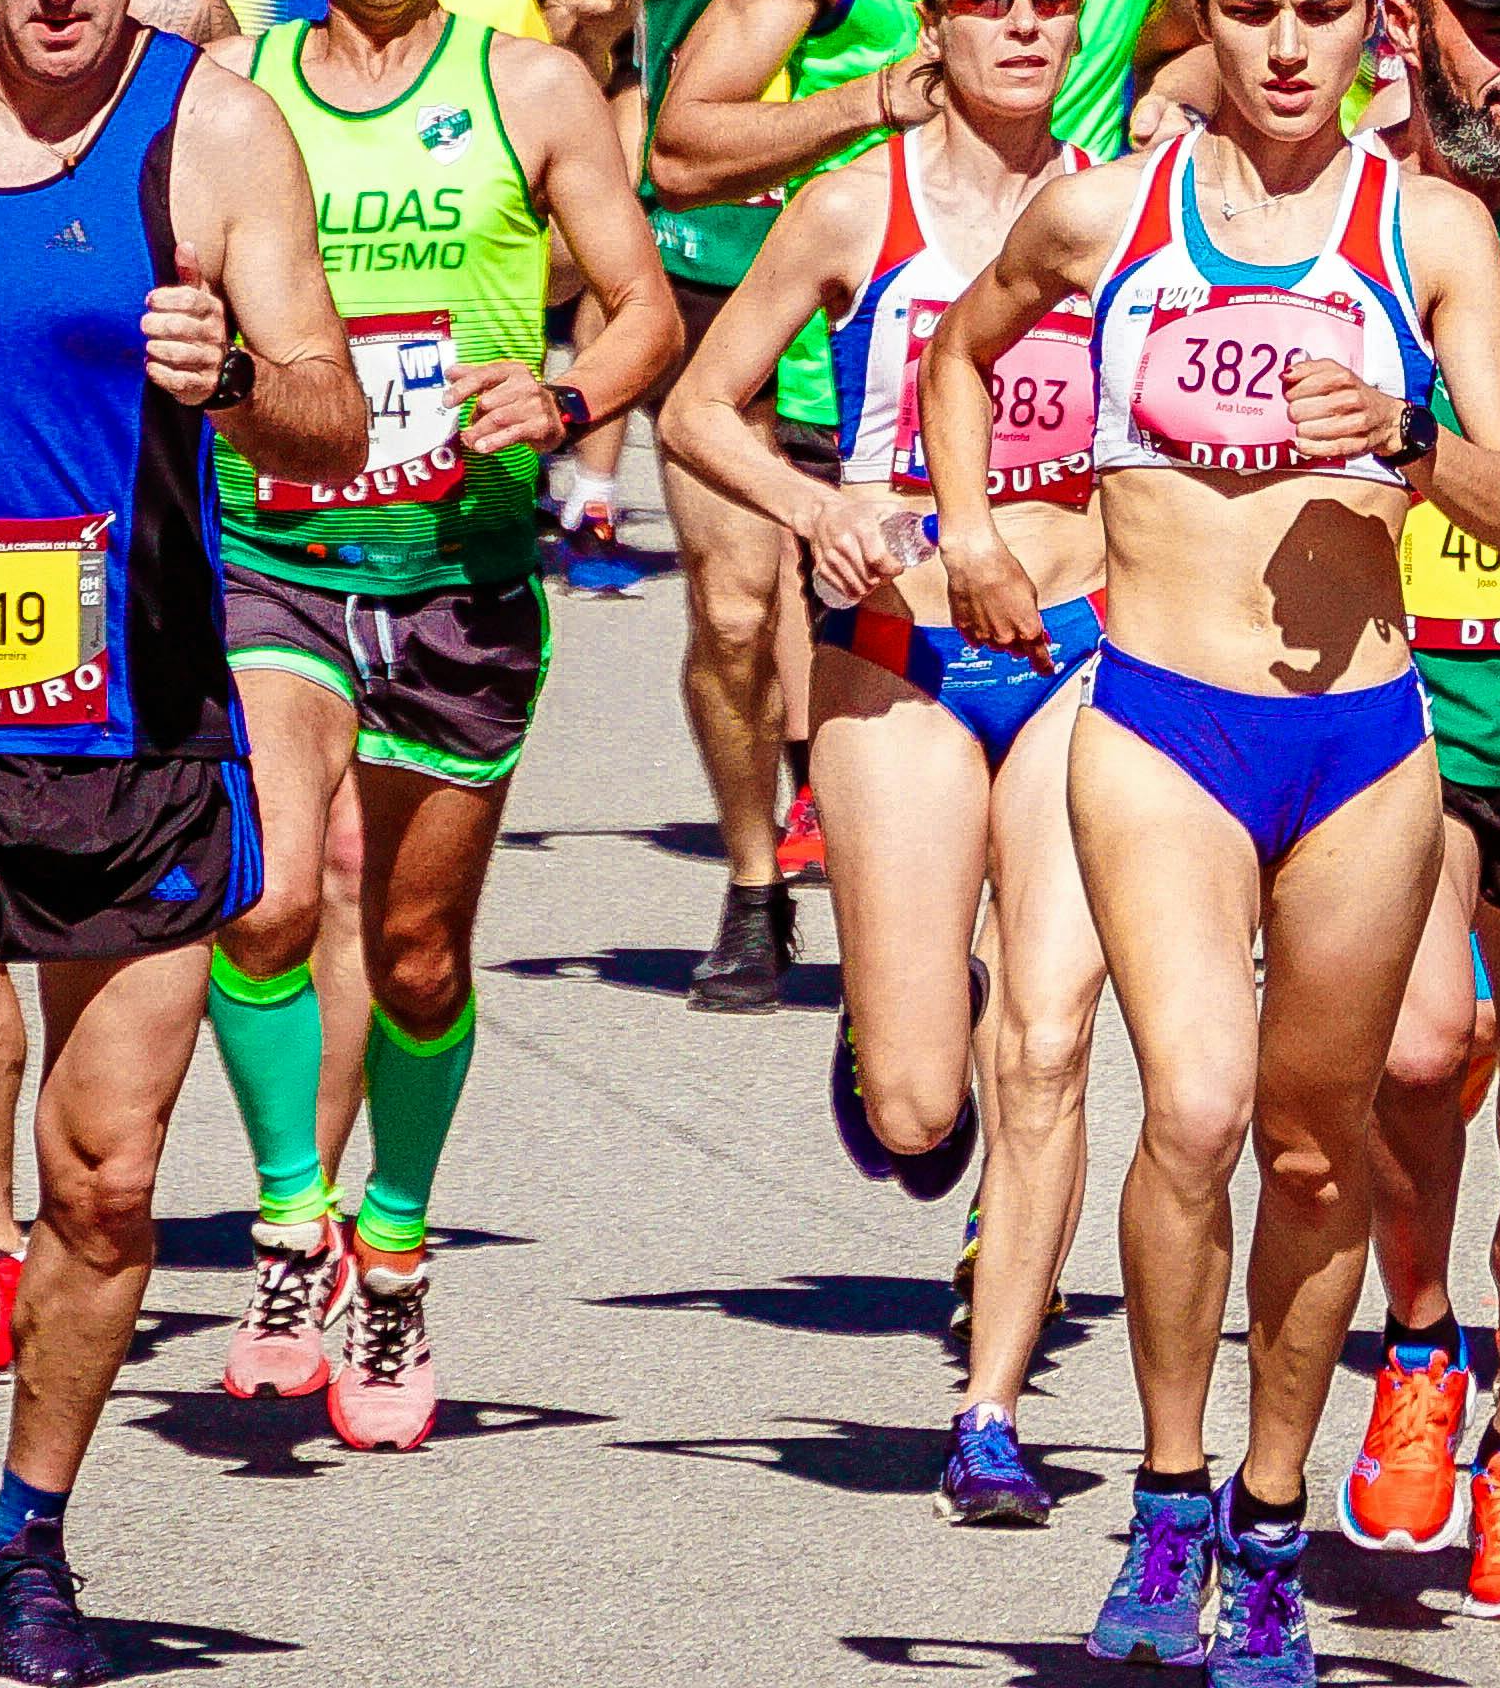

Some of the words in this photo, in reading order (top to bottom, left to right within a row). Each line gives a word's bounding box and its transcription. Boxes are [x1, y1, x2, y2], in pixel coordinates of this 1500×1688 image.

[320, 189, 463, 235] LDAS
[322, 240, 466, 272] ETISMO
[400, 345, 440, 381] VIP
[986, 450, 1092, 495] OURO
[80, 592, 99, 606] 02
